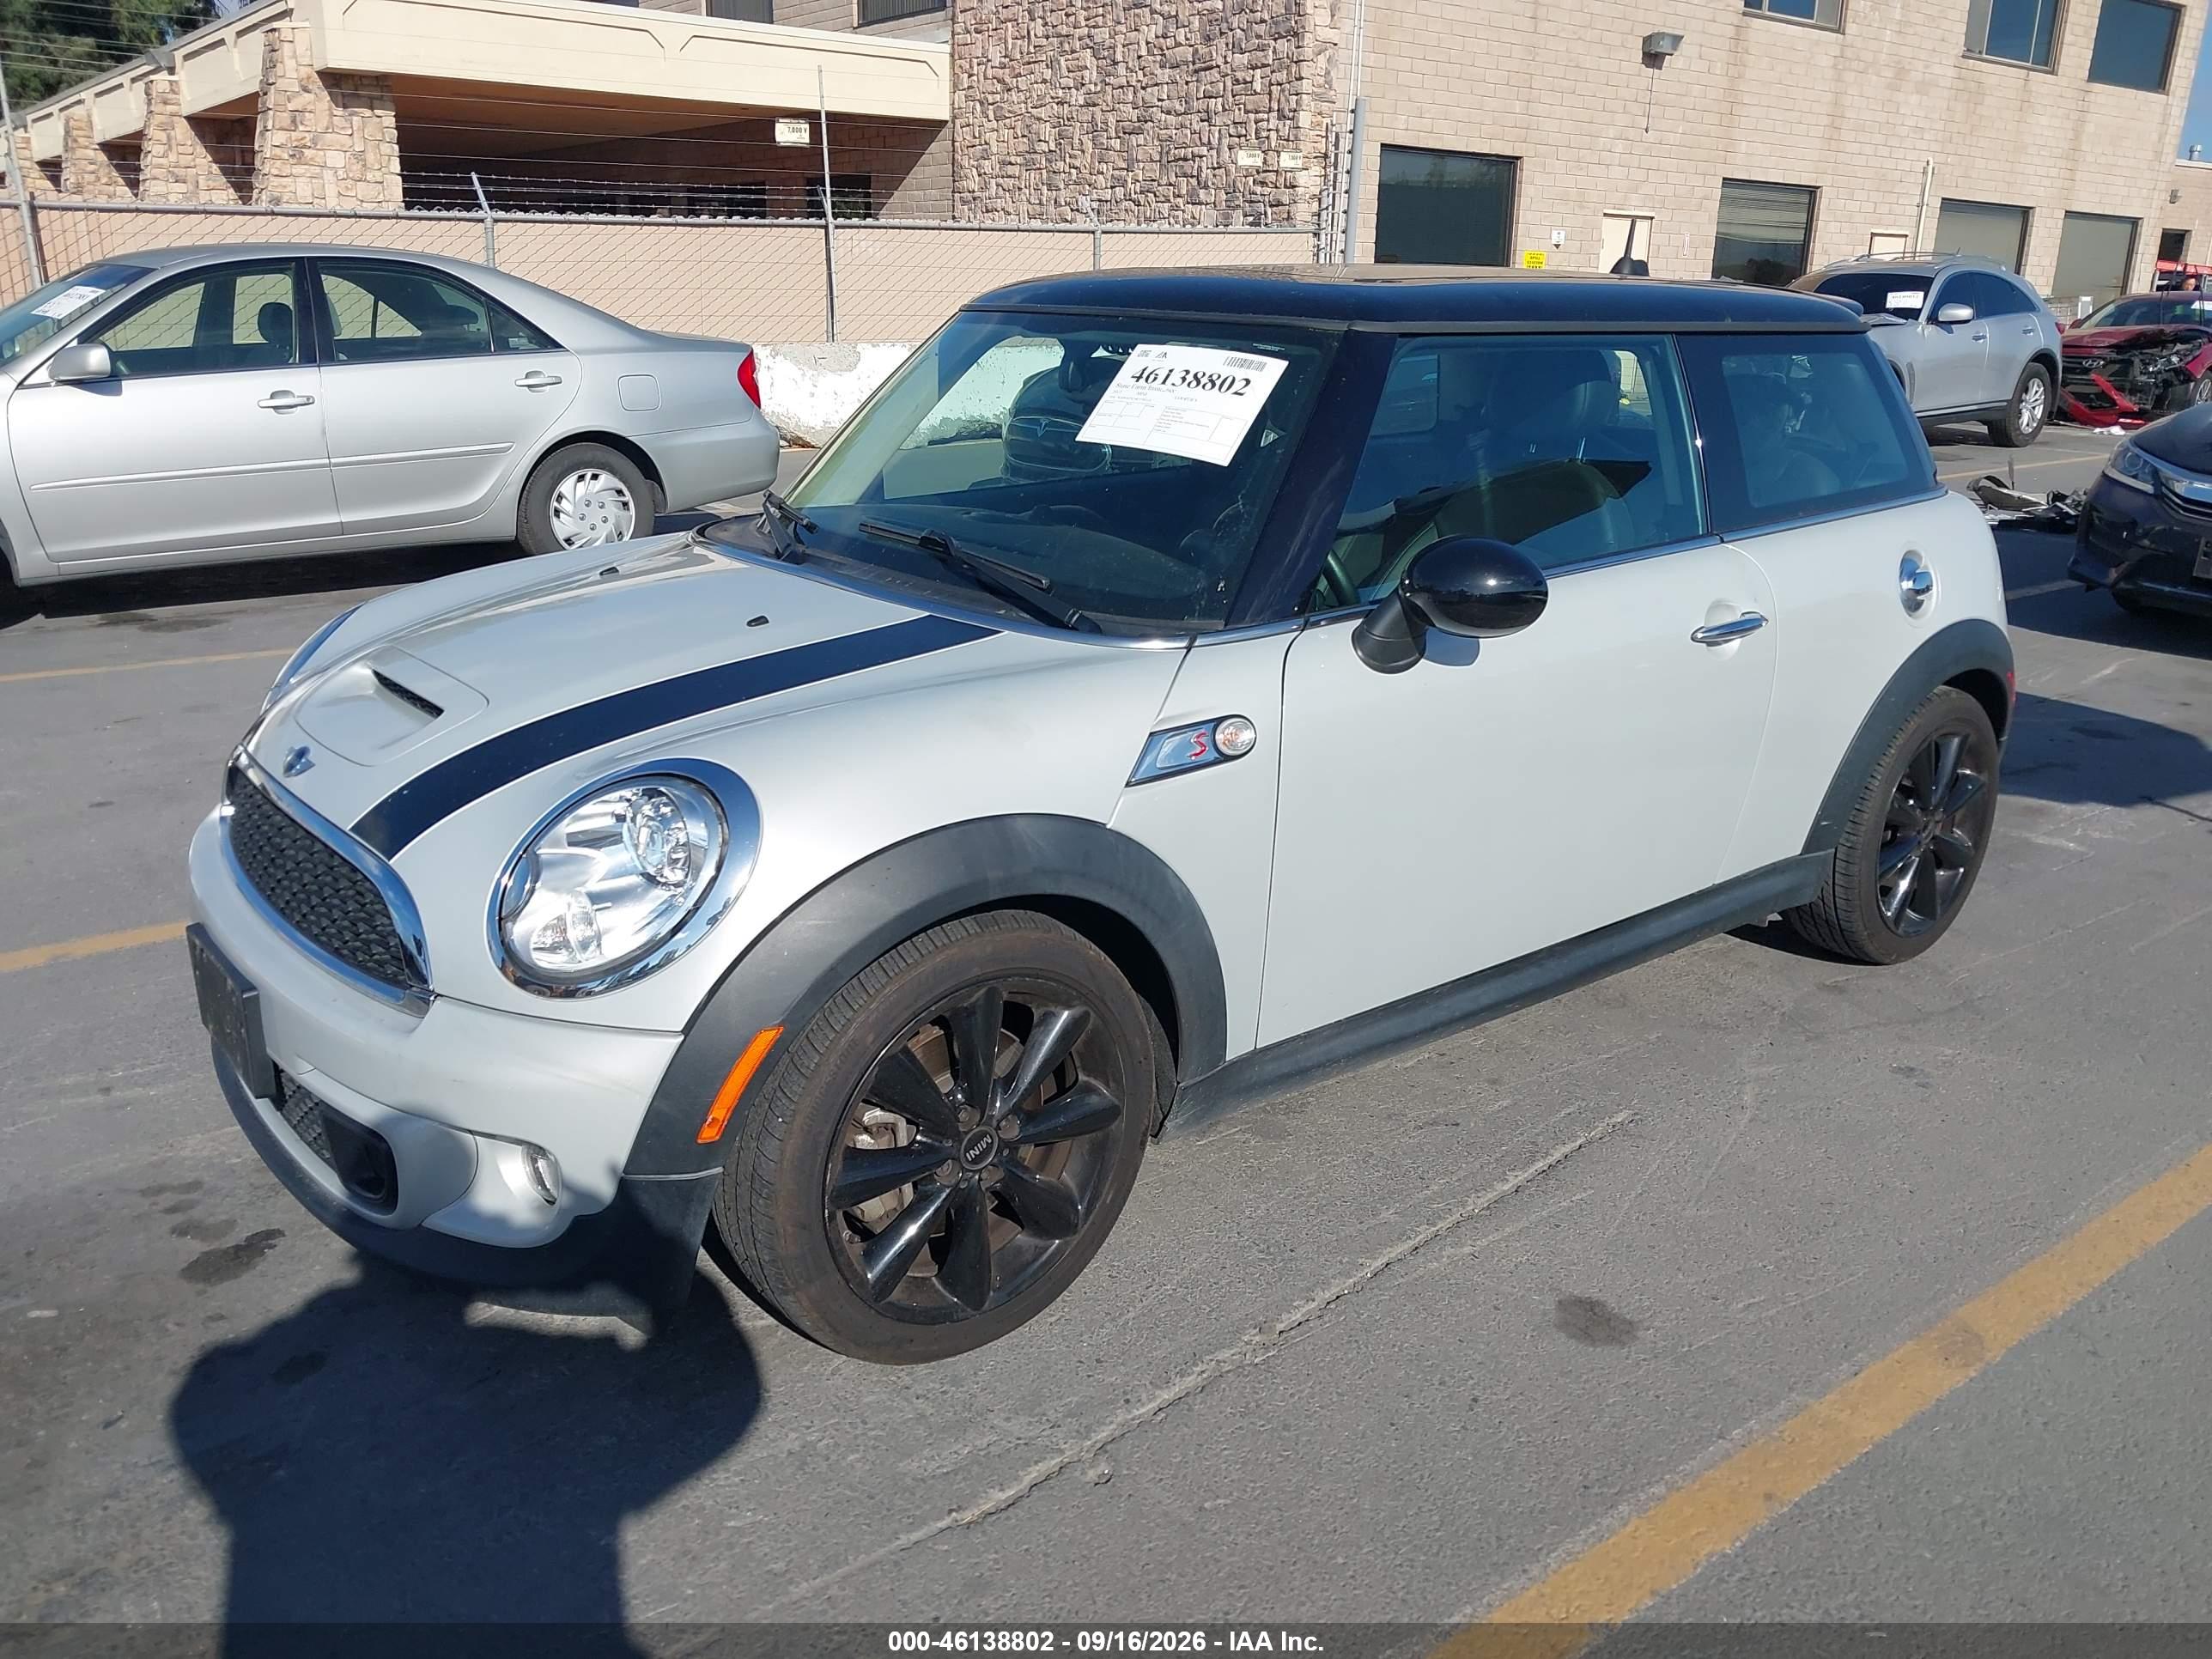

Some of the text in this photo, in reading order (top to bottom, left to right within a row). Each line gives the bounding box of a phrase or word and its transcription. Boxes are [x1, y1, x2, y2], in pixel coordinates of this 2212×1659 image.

[1130, 365, 1251, 397] 46138802
[1188, 727, 1209, 760] S
[965, 1133, 993, 1162] MINI
